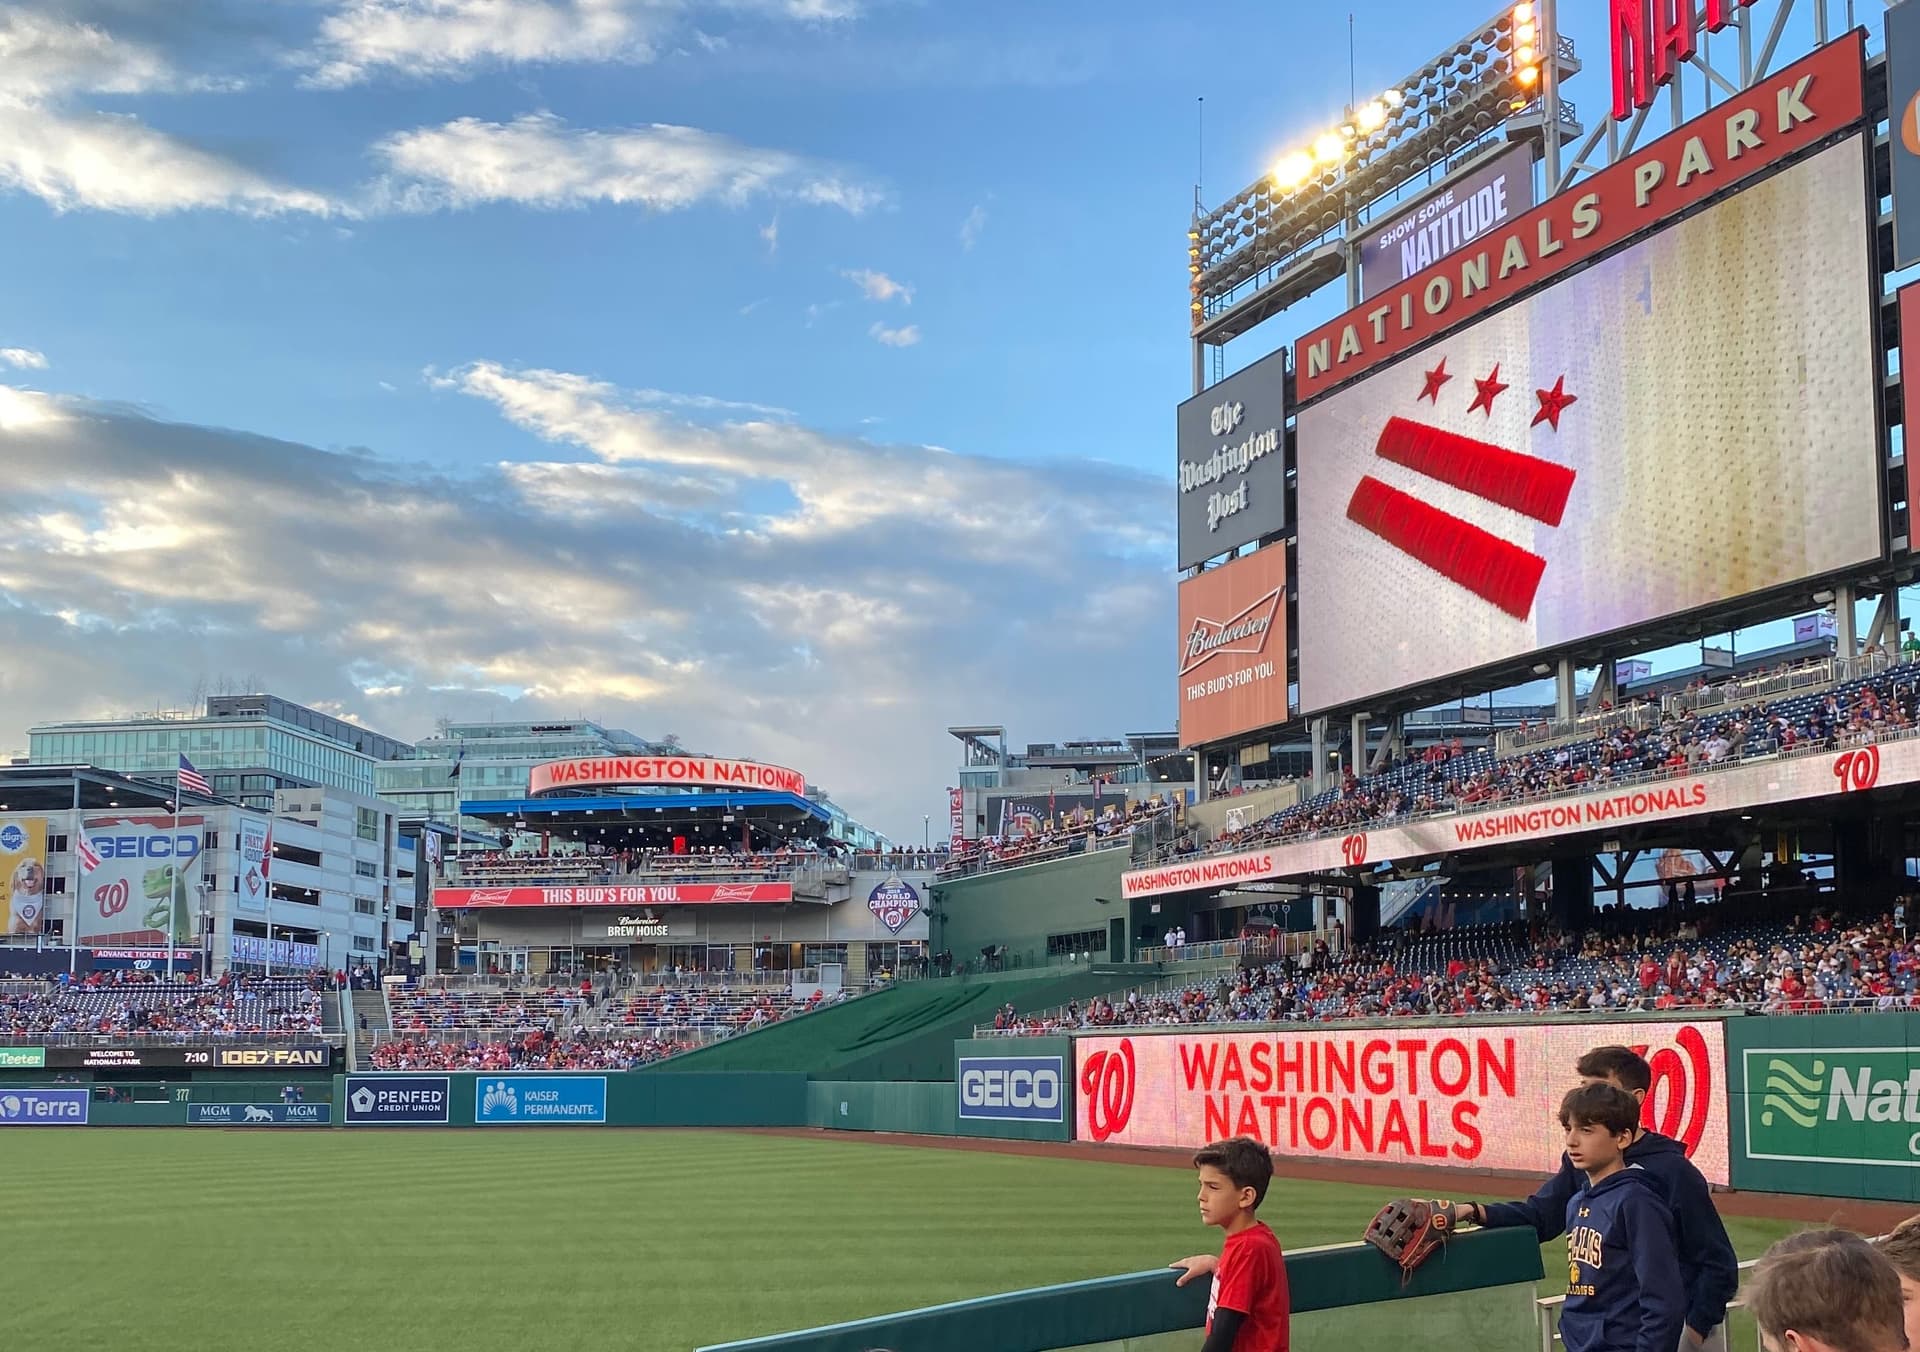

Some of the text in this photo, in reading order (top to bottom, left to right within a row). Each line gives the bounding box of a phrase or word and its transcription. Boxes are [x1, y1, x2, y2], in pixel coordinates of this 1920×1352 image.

[1306, 73, 1818, 380] NATIONALS PARK
[1379, 190, 1454, 249] SHOW SOME
[1400, 174, 1508, 281] NATITUDE
[1210, 400, 1244, 436] The
[1179, 428, 1281, 494] Washington
[1207, 479, 1249, 533] Post
[1186, 616, 1271, 658] Budweiser
[1187, 660, 1276, 701] THIS BUD'S FOR YOU.
[550, 759, 705, 784] WASHINGTON
[1455, 784, 1707, 843] WASHINGTON NATIONALS
[90, 835, 199, 859] GEICO
[1126, 868, 1200, 893] WASHINGTON
[1203, 856, 1272, 882] NATIONALS
[542, 886, 681, 904] THIS BUD'S FOR YOU.
[869, 899, 919, 909] CHAMPIONS
[876, 892, 911, 900] WORLD
[607, 925, 668, 937] BREW HOUSE
[617, 916, 659, 926] Budweiser
[135, 951, 162, 959] TICKET
[163, 951, 187, 959] SLES
[0, 1053, 41, 1064] Teeter
[183, 1052, 209, 1063] 7:10
[274, 1050, 323, 1064] FAN
[1178, 1038, 1516, 1097] WASHINGTON
[175, 1088, 190, 1102] 377
[378, 1090, 442, 1103] PENFED
[524, 1090, 559, 1102] KAISER
[962, 1069, 1059, 1109] GEICO
[22, 1097, 80, 1117] Terra
[200, 1106, 231, 1116] MGM
[286, 1106, 317, 1116] MGM
[378, 1104, 441, 1112] CREDIT UNION
[1204, 1095, 1483, 1161] NATIONALS
